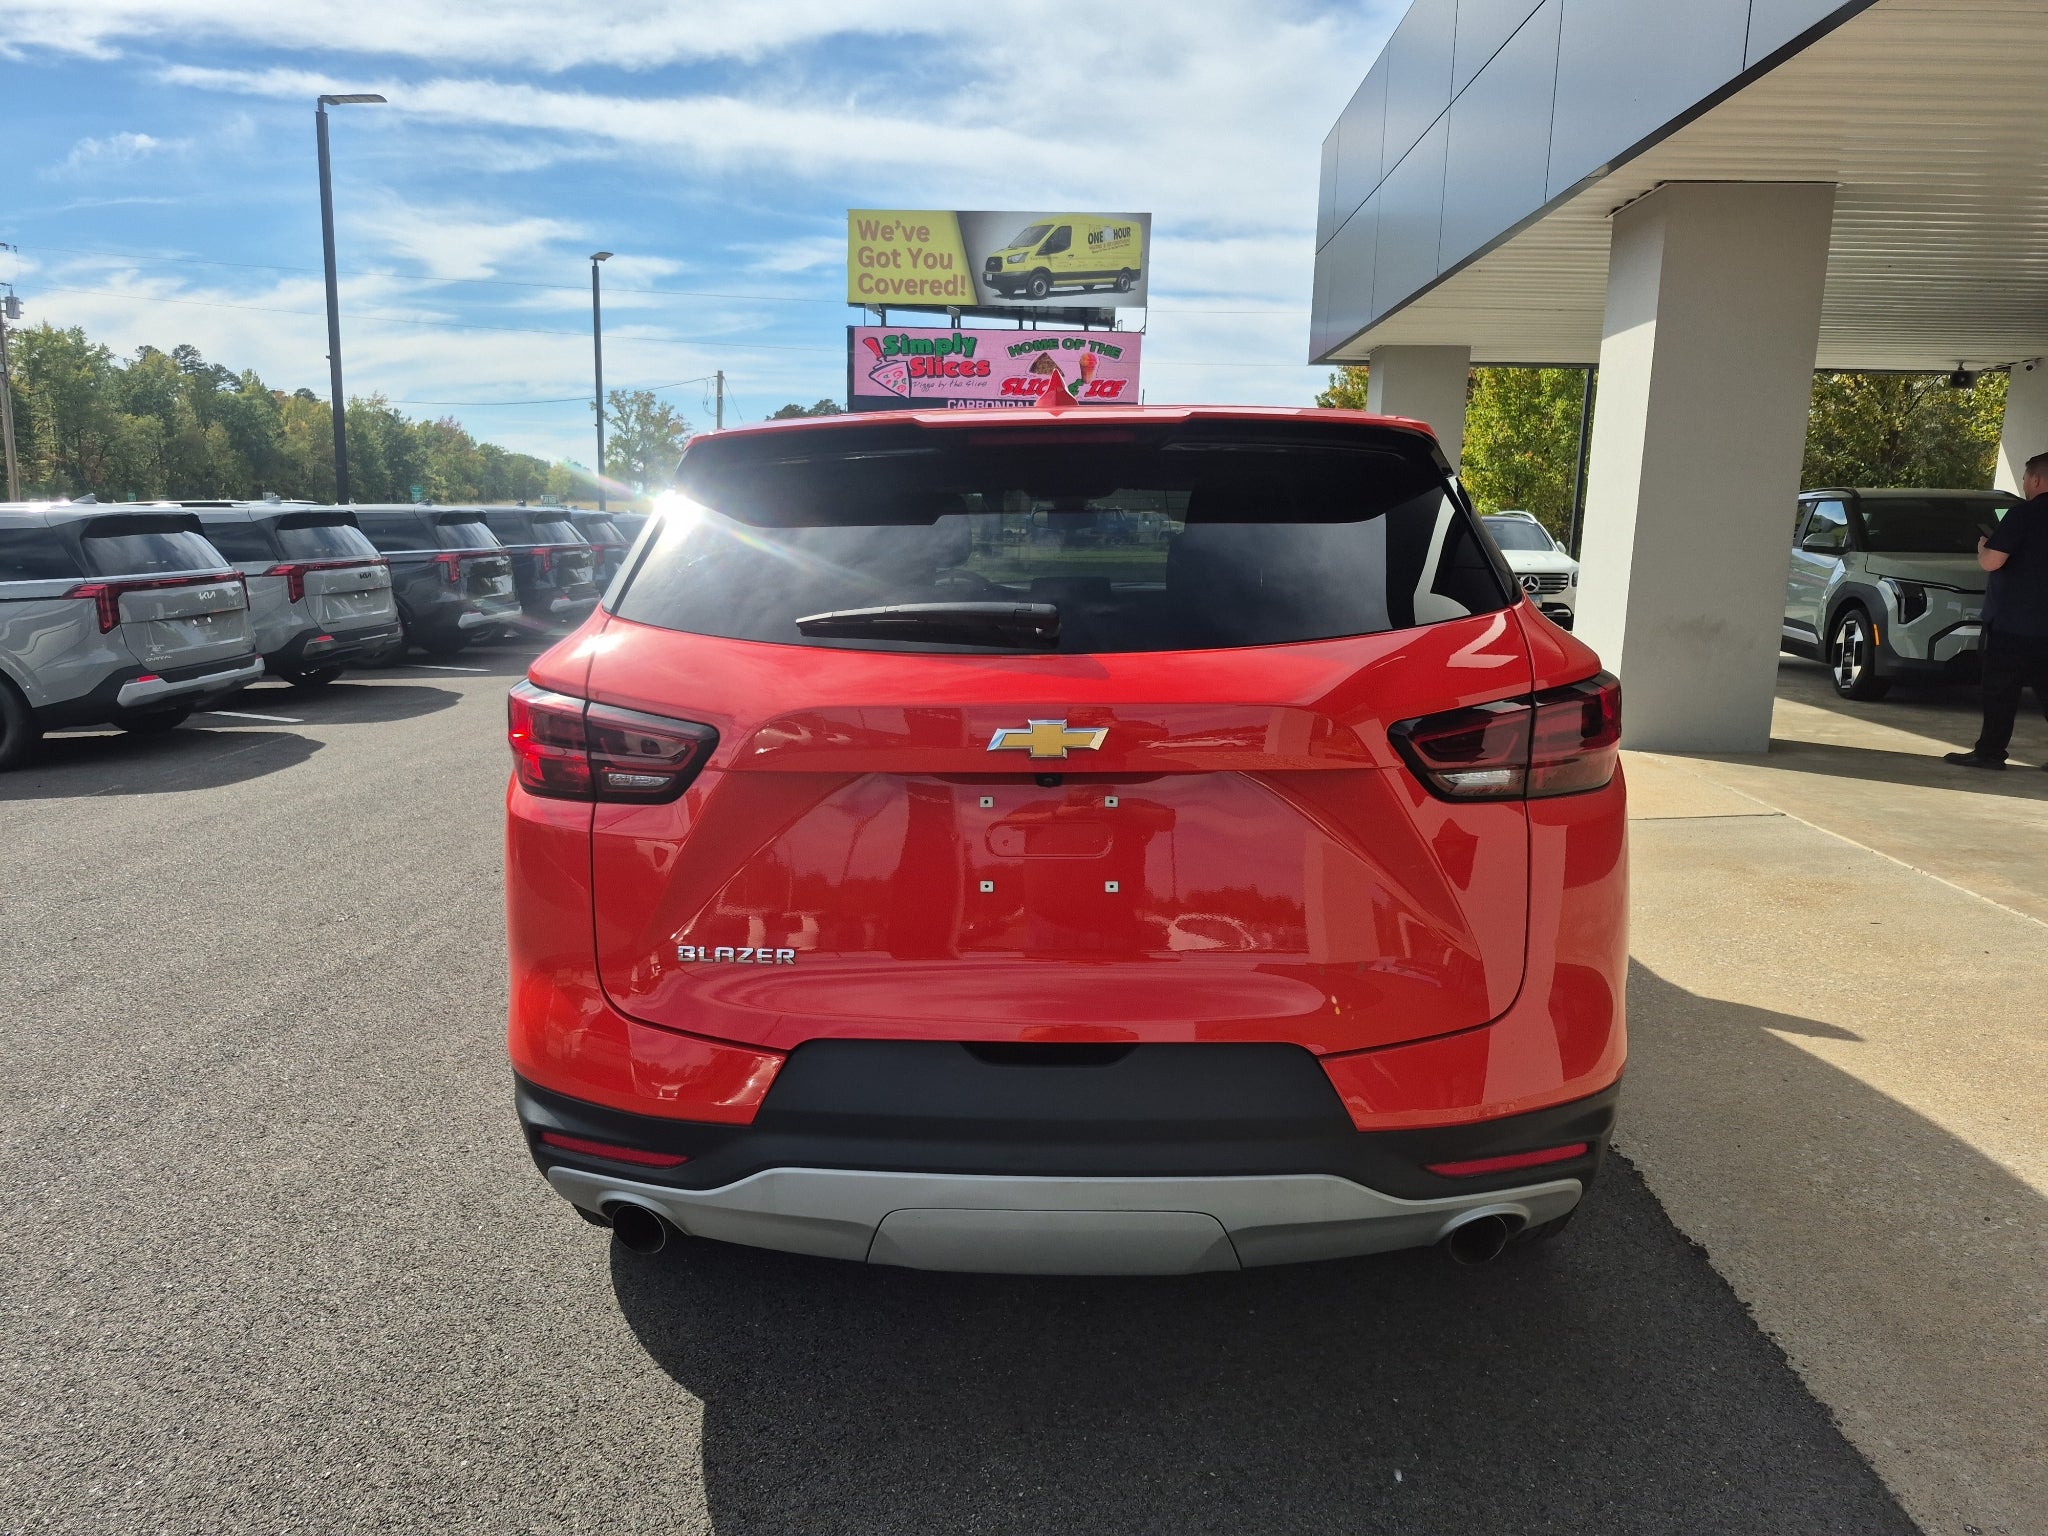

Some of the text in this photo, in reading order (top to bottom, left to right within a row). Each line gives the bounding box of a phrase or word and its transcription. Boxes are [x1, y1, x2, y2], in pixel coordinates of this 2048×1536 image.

[857, 219, 930, 243] We've
[1088, 231, 1103, 245] ONE
[1113, 227, 1131, 240] HOUR
[857, 246, 953, 270] Got You
[857, 273, 966, 297] Covered!
[883, 333, 978, 358] Simply
[1007, 338, 1122, 360] HOME OF THE
[910, 356, 991, 378] Slices
[1000, 377, 1052, 396] SLIC
[1084, 379, 1127, 398] ICE
[947, 399, 1036, 409] CARBONDAL
[677, 945, 795, 965] BLAZER
